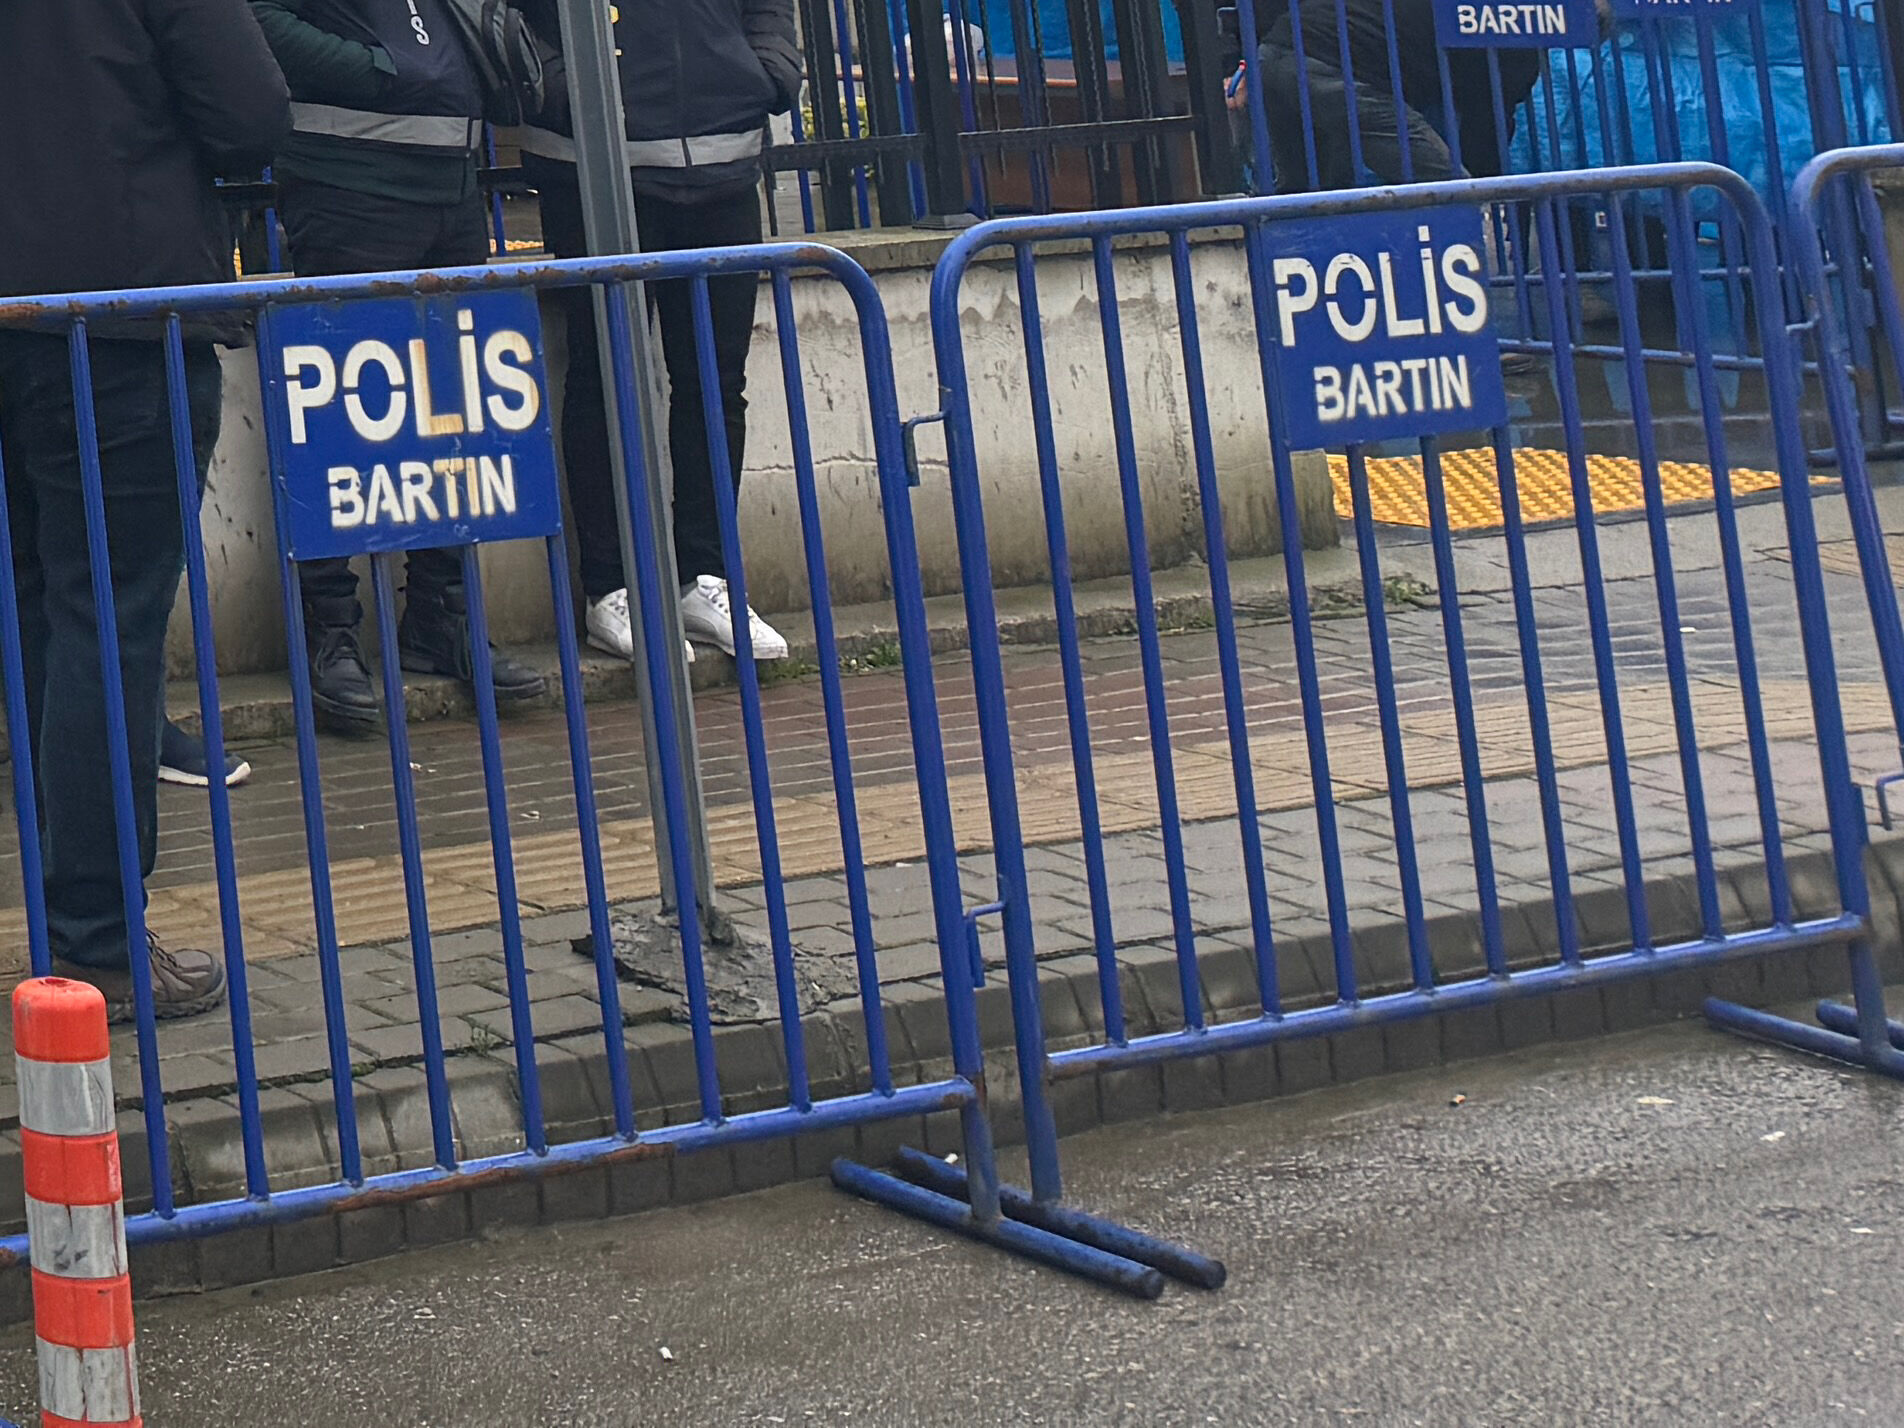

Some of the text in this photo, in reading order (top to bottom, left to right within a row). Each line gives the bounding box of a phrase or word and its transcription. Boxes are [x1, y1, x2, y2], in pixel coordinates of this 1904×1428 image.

[1456, 3, 1567, 35] BARTIN
[1272, 224, 1489, 348] POLİS
[282, 308, 541, 445] POLİS
[1313, 354, 1473, 423] BARTIN
[327, 453, 517, 529] BARTIN
